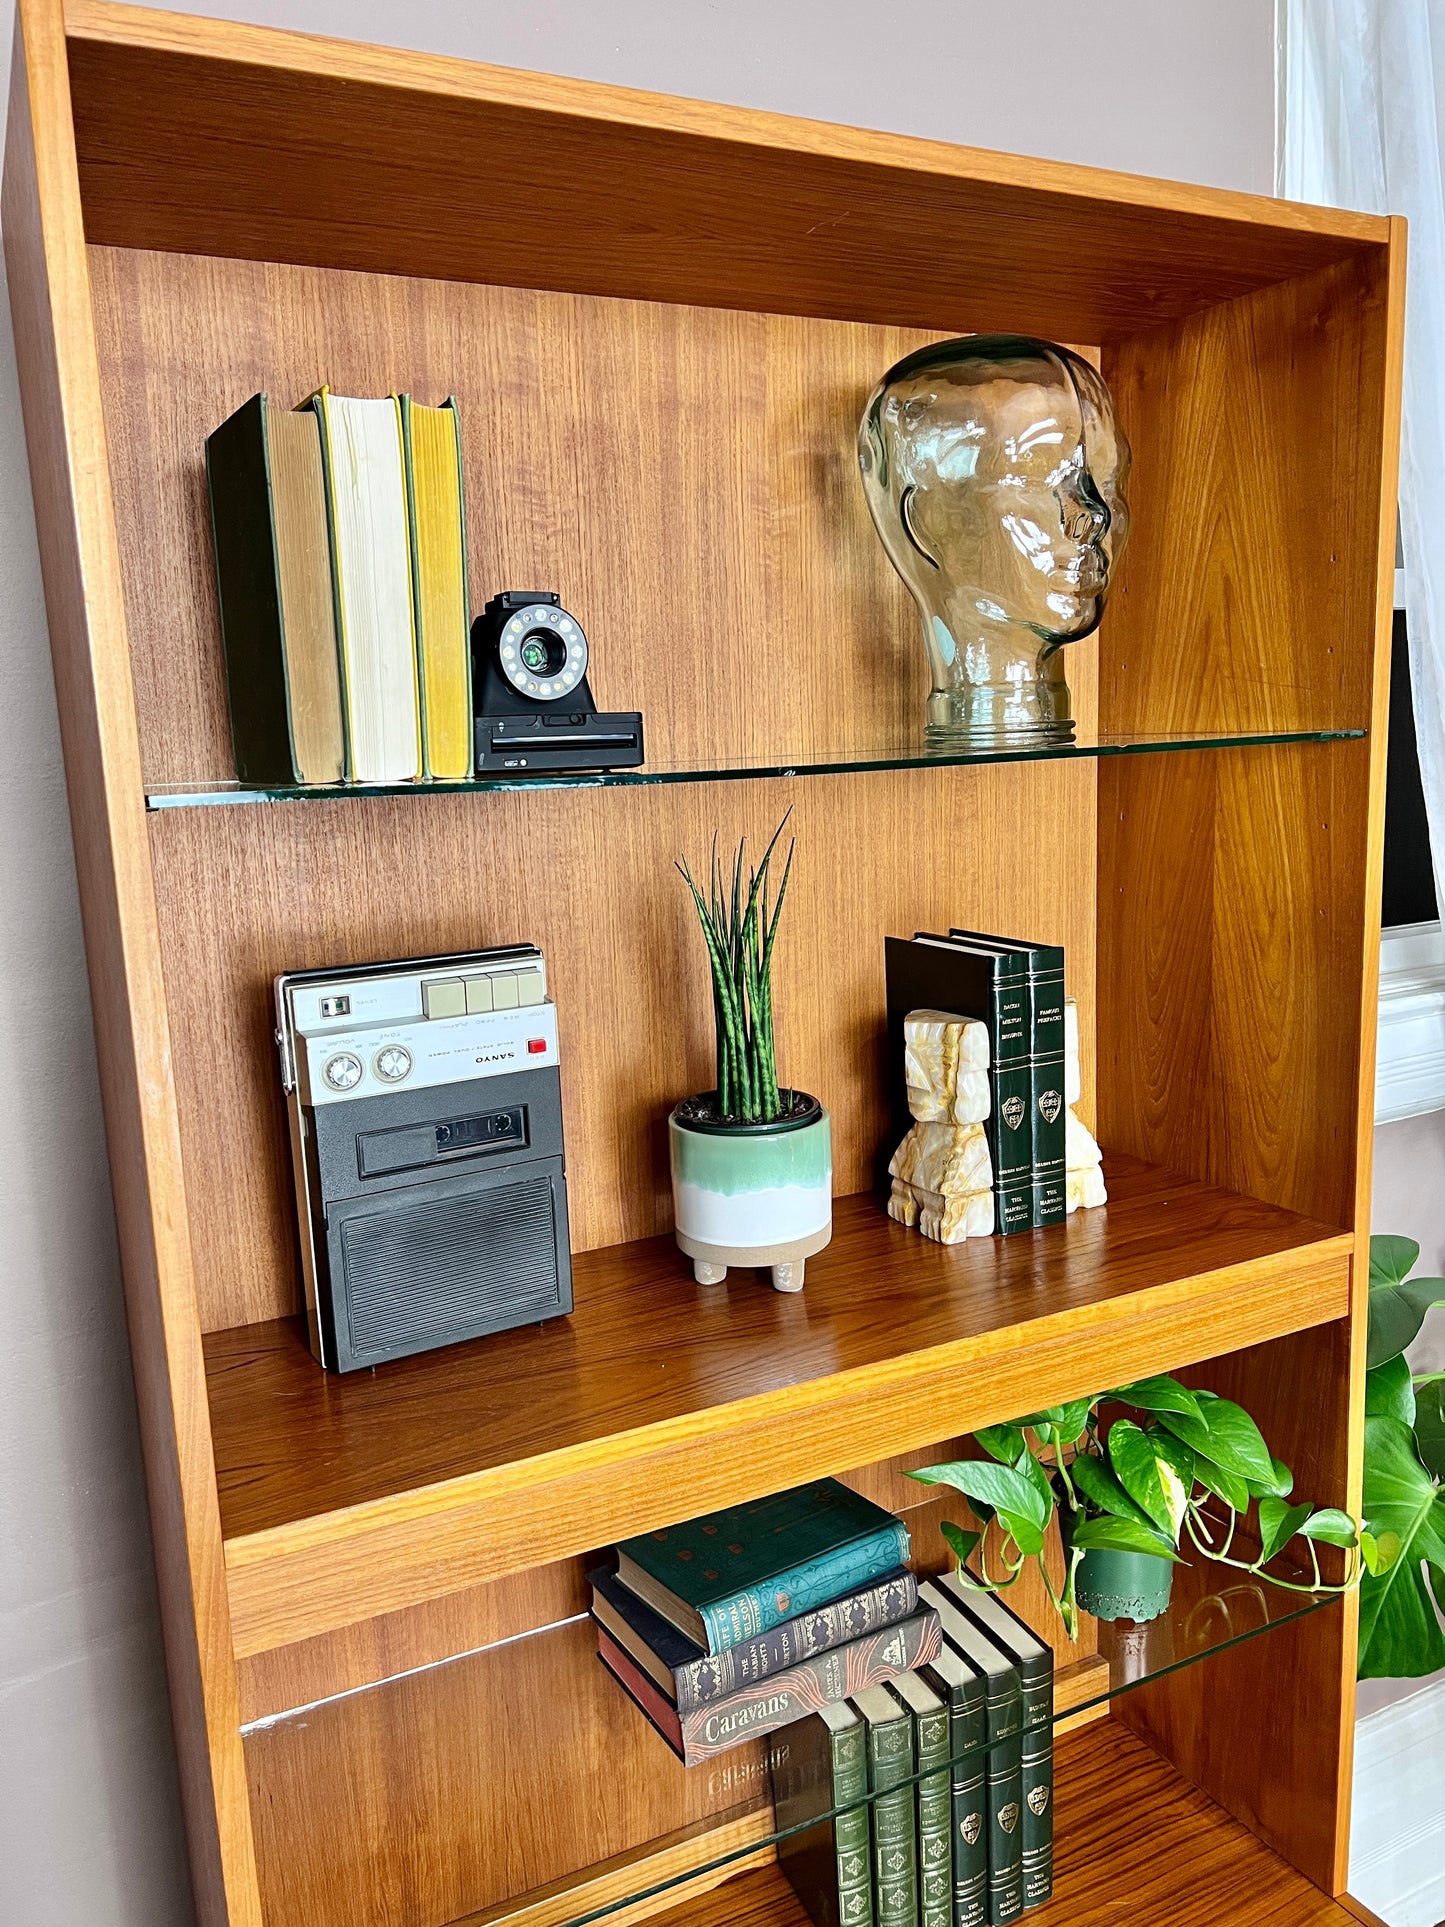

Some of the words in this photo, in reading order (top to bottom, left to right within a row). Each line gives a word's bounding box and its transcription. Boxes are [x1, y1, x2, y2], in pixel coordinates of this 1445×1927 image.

[327, 1038, 356, 1047] VOLUME
[379, 1032, 401, 1040] TONE
[428, 1050, 450, 1058] POWER
[475, 1052, 515, 1064] SANYO
[716, 1608, 726, 1621] OF
[728, 1602, 742, 1642] ADMIRAL
[738, 1599, 752, 1639] NELSON
[749, 1594, 762, 1633] SOUTHEY
[722, 1625, 731, 1650] LIFE
[781, 1632, 790, 1666] BURTON
[741, 1658, 750, 1677] THE
[750, 1644, 758, 1679] ARABIAN
[760, 1643, 769, 1673] NIGHTS
[826, 1671, 835, 1698] JAMES
[705, 1692, 789, 1742] Caravans
